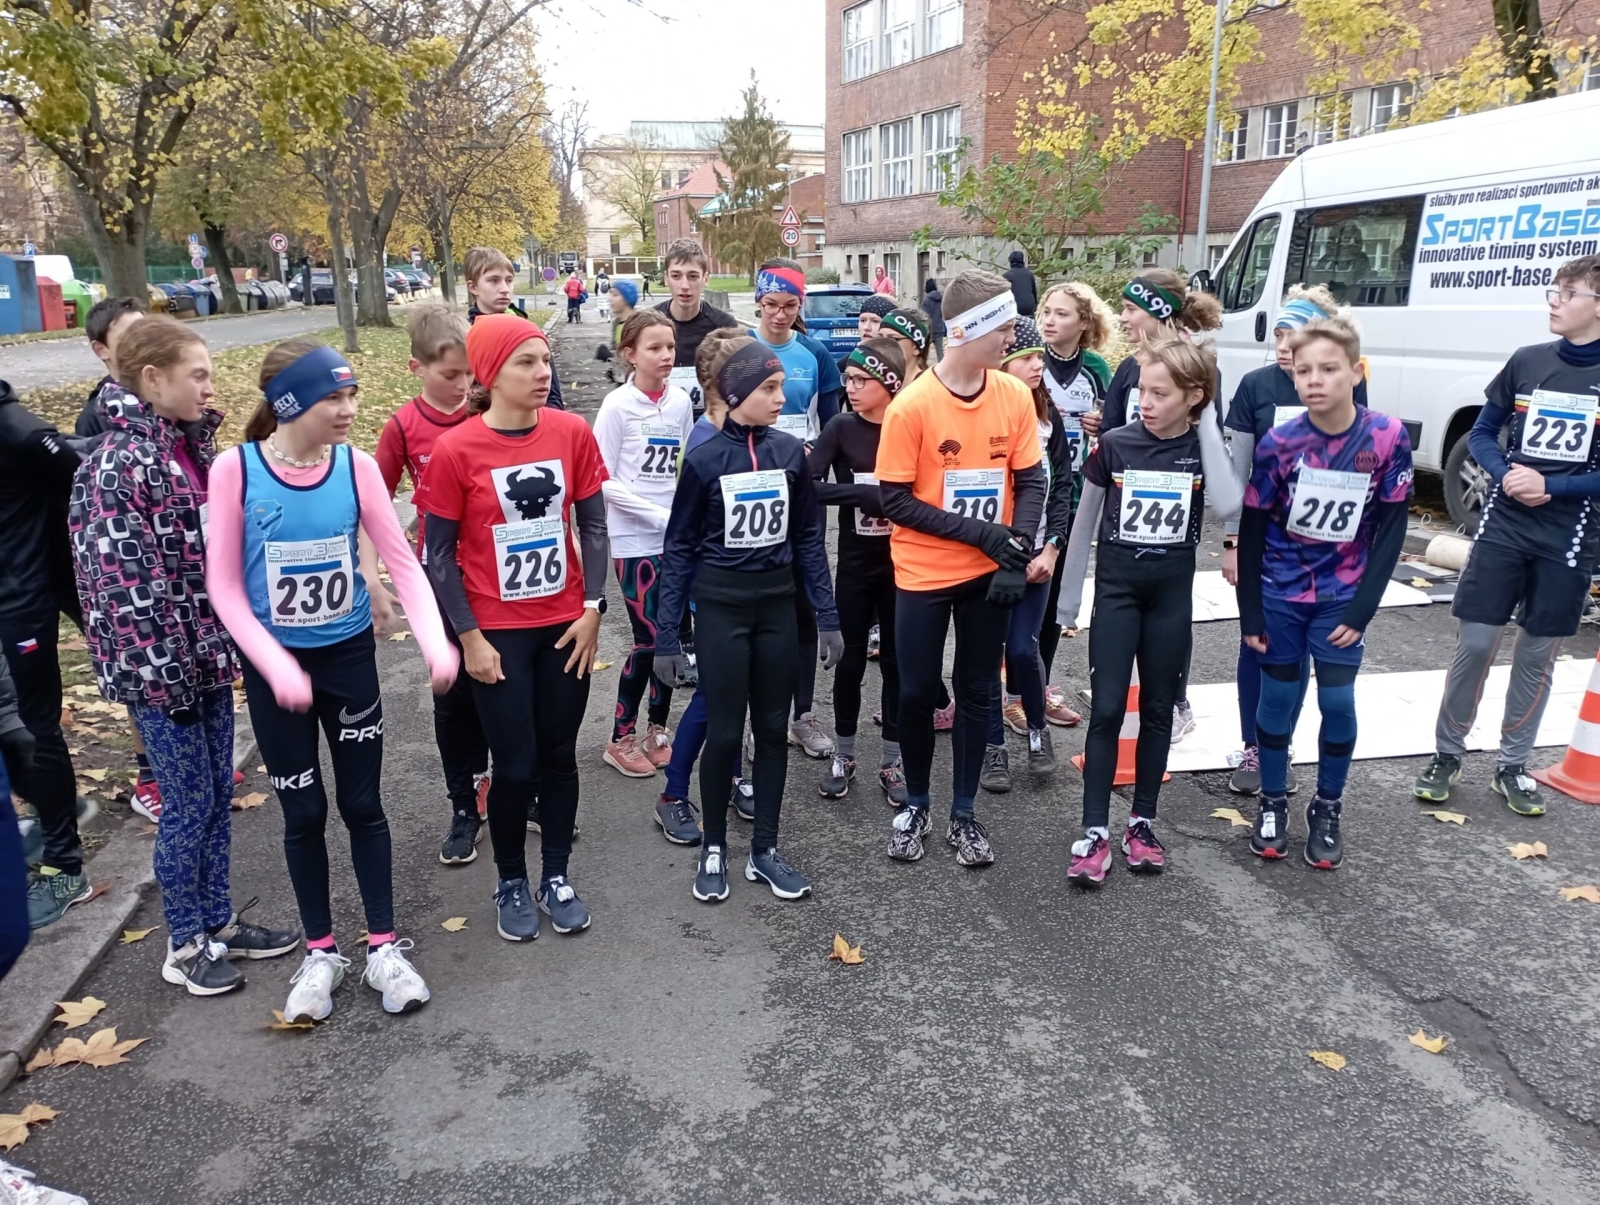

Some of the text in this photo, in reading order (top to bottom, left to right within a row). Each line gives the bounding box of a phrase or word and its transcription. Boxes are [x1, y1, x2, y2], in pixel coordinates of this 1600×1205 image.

[1430, 193, 1458, 207] služby
[1458, 192, 1474, 206] pro
[1475, 185, 1519, 202] realizaci
[1519, 177, 1584, 199] sportovních
[786, 232, 796, 240] 20
[1418, 240, 1598, 264] innovative timing system
[1430, 265, 1555, 290] www.sport-base.
[1527, 417, 1588, 452] 223
[641, 445, 681, 474] 225
[729, 499, 786, 539] 208
[952, 497, 998, 523] 219
[1123, 499, 1186, 534] 244
[1295, 497, 1357, 533] 218
[1121, 532, 1184, 541] www.sport-base.cz
[504, 547, 562, 591] 226
[276, 571, 348, 616] 230
[274, 608, 351, 624] www.sport-base.cz
